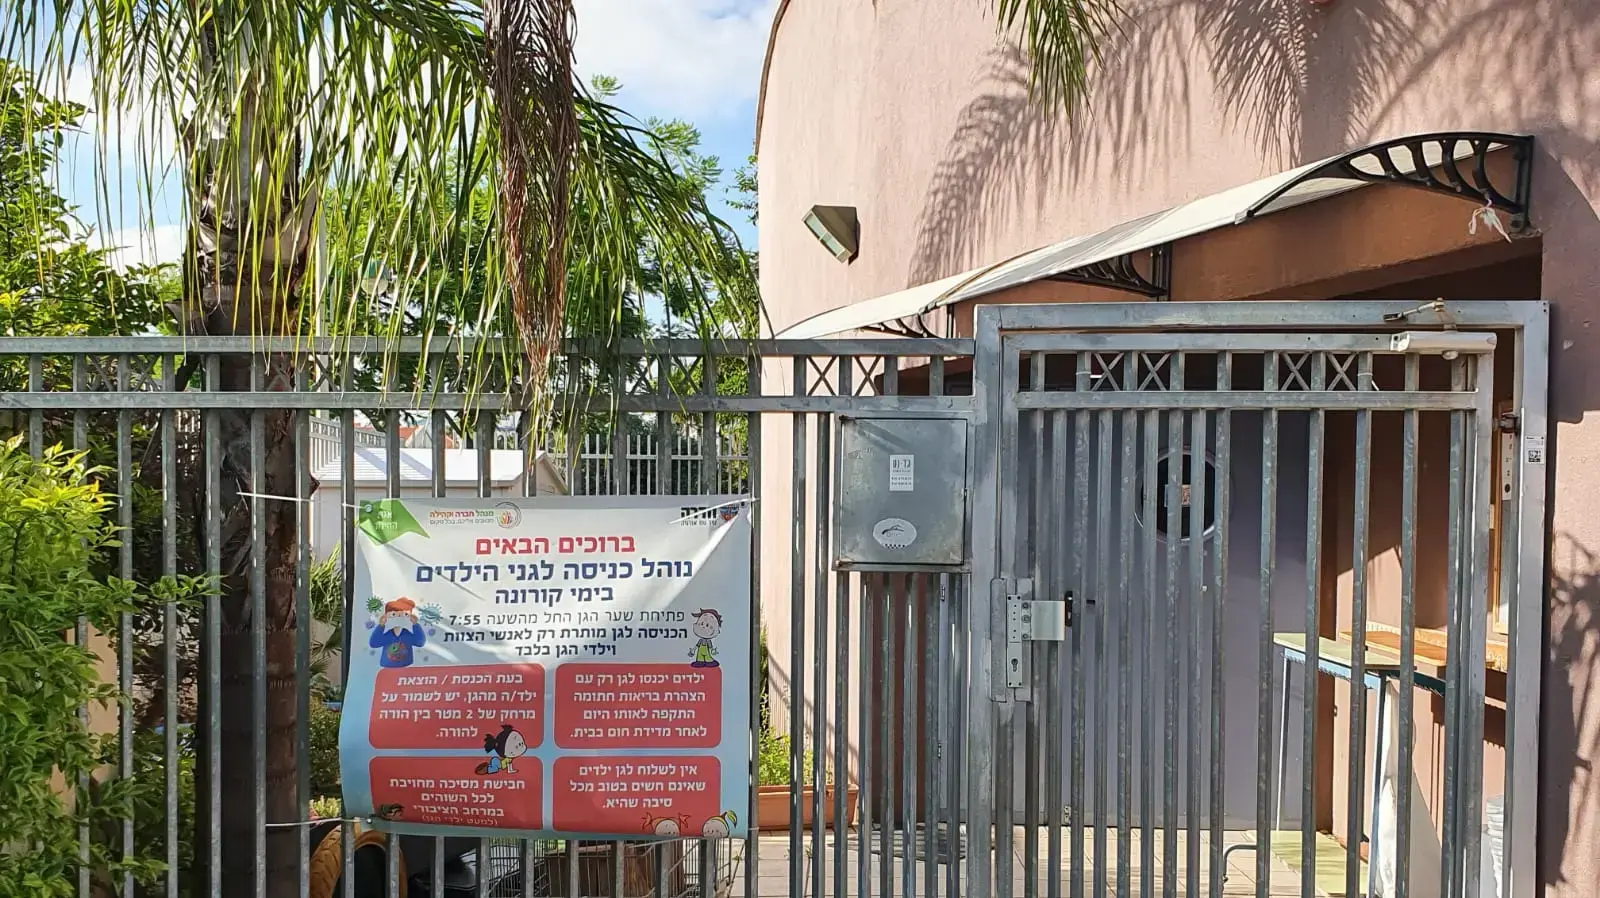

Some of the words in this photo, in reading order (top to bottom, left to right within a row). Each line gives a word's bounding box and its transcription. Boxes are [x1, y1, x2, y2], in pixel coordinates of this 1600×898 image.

[429, 510, 454, 519] וקהילה
[476, 537, 549, 555] הבאים
[559, 536, 635, 553] ברוכים
[416, 561, 498, 582] הילדים
[508, 560, 554, 580] לגני
[564, 562, 633, 580] כניסה
[641, 558, 693, 578] נוהל
[495, 588, 563, 607] קורונה
[571, 587, 613, 602] בימי
[449, 615, 481, 625] 7:55
[487, 614, 537, 625] מהשעה
[544, 611, 571, 623] החל
[578, 611, 598, 625] הגן
[604, 611, 633, 622] שער
[640, 611, 685, 622] פתיחת
[443, 631, 485, 642] הצוות
[490, 628, 532, 641] לאנשי
[537, 629, 555, 642] רק
[560, 627, 606, 639] מותרת
[612, 626, 632, 641] לגן
[638, 628, 687, 639] הכניסה
[515, 644, 550, 656] בלבד
[556, 644, 578, 658] הגן
[583, 643, 616, 655] וילדי
[397, 675, 437, 686] הוצאת
[451, 674, 492, 684] הכנסת
[496, 673, 523, 684] בעת
[575, 675, 593, 684] עם
[597, 675, 613, 687] רק
[617, 673, 635, 686] לגן
[640, 675, 669, 684] יכנסו
[672, 673, 705, 684] ילדים
[382, 692, 397, 702] על
[401, 691, 442, 702] לשמור
[445, 692, 460, 702] יש
[501, 690, 537, 702] ילד/ה
[573, 692, 615, 702] חתומה
[618, 692, 660, 702] בריאות
[664, 691, 706, 702] הצהרת
[379, 709, 409, 719] הורה
[413, 709, 430, 722] בין
[435, 709, 461, 719] מטר
[466, 709, 473, 719] 2
[478, 708, 496, 719] של
[500, 709, 536, 722] מרחק
[583, 709, 610, 720] היום
[614, 708, 648, 719] לאותו
[652, 709, 695, 722] התקפה
[435, 726, 478, 738] להורה.
[570, 727, 604, 738] בבית.
[608, 727, 630, 737] חום
[633, 727, 671, 737] מדידת
[675, 725, 707, 737] לאחר
[579, 764, 611, 776] ילדים
[615, 763, 633, 778] לגן
[637, 763, 676, 775] לשלוח
[681, 765, 697, 778] אין
[389, 778, 435, 788] מחויבת
[439, 778, 479, 789] מסיכה
[483, 779, 525, 789] חבישת
[569, 780, 594, 792] מכל
[598, 782, 627, 792] בטוב
[631, 781, 664, 792] חשים
[668, 781, 706, 791] שאינם
[421, 792, 467, 803] השוהים
[472, 793, 495, 804] לכל
[602, 798, 638, 808] שהיא.
[643, 798, 672, 808] סיבה
[413, 804, 458, 815] הציבורי
[463, 806, 504, 817] במרחב
